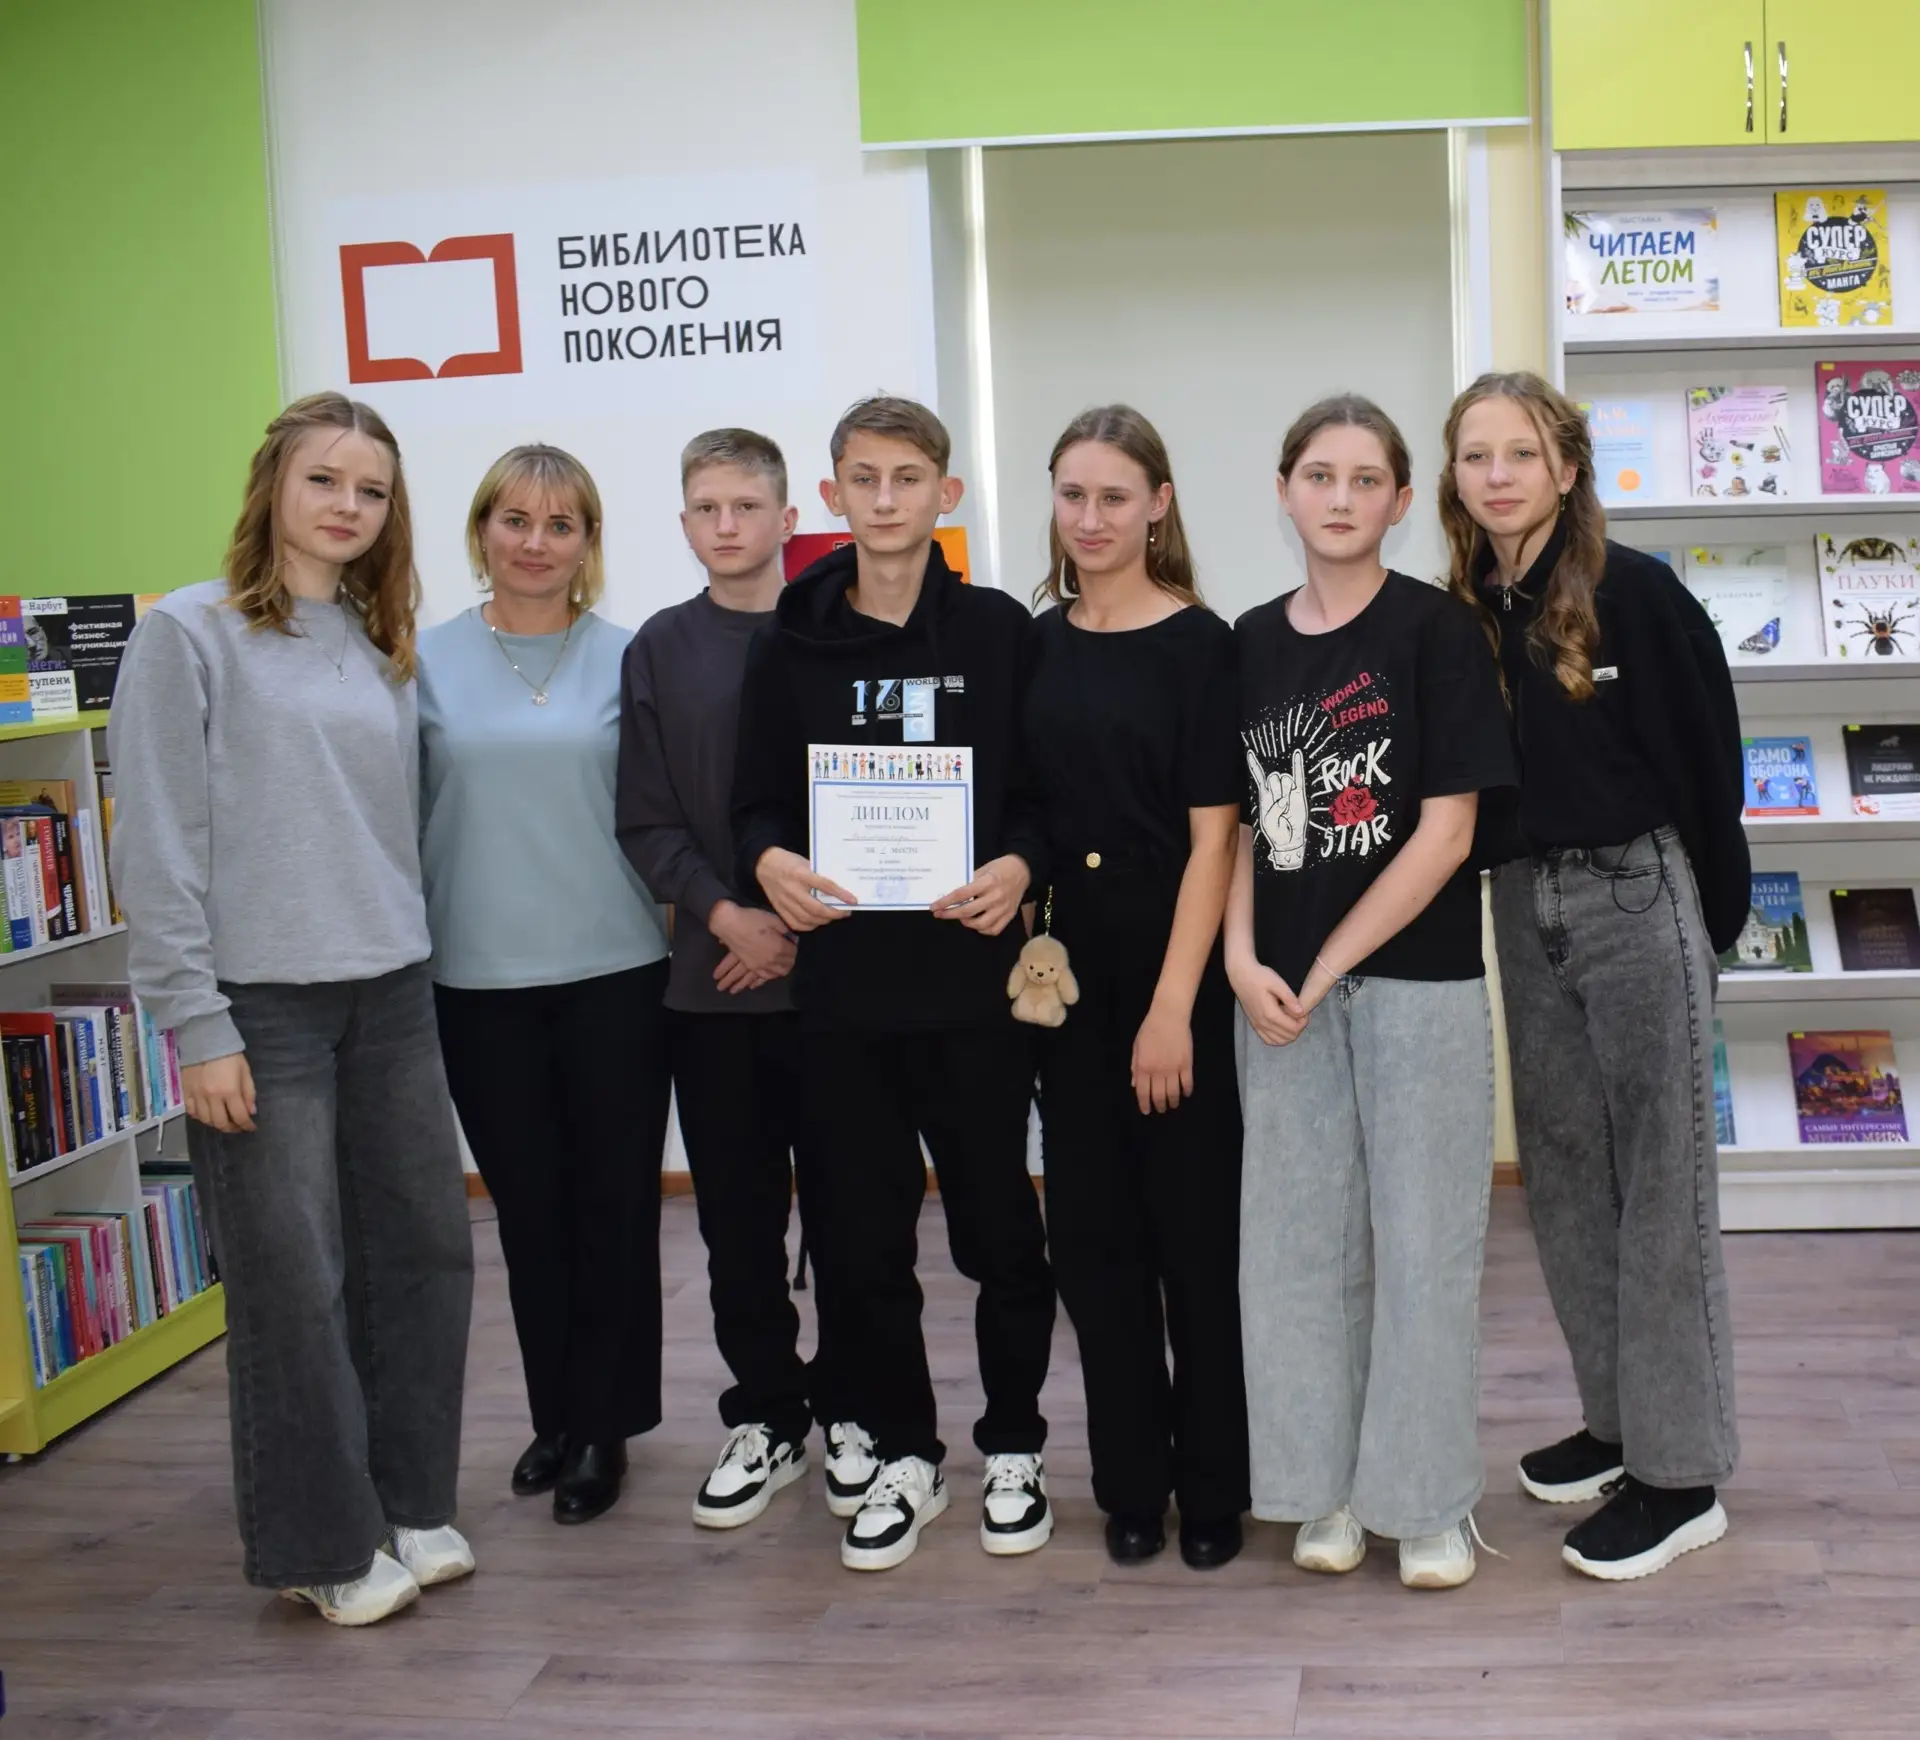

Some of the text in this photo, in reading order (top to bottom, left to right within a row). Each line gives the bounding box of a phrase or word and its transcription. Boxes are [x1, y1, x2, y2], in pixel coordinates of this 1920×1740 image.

[557, 222, 807, 270] БИБЛИОТЕКА
[1589, 230, 1695, 257] ЧИТАЕМ
[1806, 225, 1867, 250] СУПЕР
[1822, 248, 1854, 260] КУРС
[1601, 258, 1693, 285] ЛЕТОМ
[1826, 275, 1860, 290] МАНГА
[560, 275, 710, 317] НОВОГО
[563, 318, 783, 364] ПОКОЛЕНИЯ
[1847, 394, 1907, 419] СУПЕР
[1838, 574, 1915, 590] ПАУКИ
[28, 601, 63, 613] Нарбут
[68, 621, 123, 632] фективная
[29, 676, 71, 689] тупени
[905, 677, 940, 687] WORLD
[1320, 671, 1373, 713] WORLD
[1331, 698, 1389, 729] LEGEND
[1320, 738, 1392, 793] ROCK
[1747, 748, 1791, 764] САМО
[1750, 764, 1811, 778] ОБОРОНА
[850, 805, 930, 822] ДИПЛОМ
[43, 825, 54, 871] ГОРБАЧЕВ
[1320, 814, 1392, 858] STAR
[63, 884, 77, 932] ЧЕРНОБЫЛЯ
[79, 1023, 89, 1071] АНТИЧНАЯ
